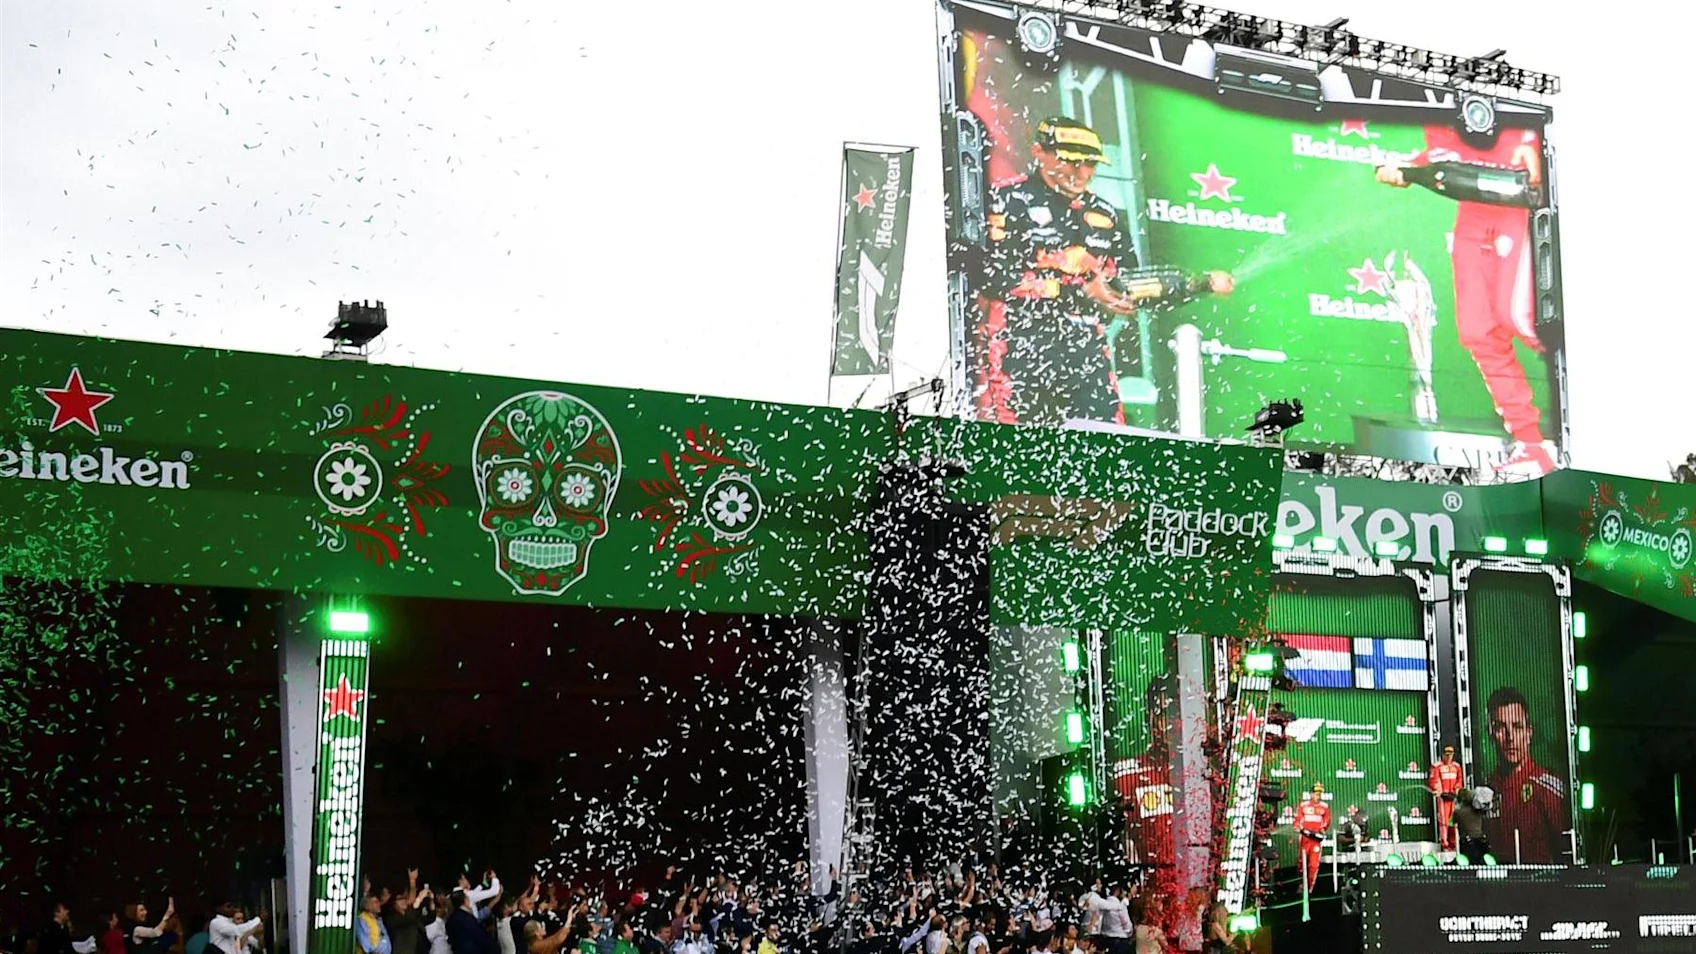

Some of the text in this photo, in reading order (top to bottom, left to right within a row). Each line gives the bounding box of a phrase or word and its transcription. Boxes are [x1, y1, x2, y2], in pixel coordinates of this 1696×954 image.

[875, 156, 901, 249] Heineken
[1147, 198, 1286, 236] Heineken
[103, 423, 123, 434] 1873
[1147, 502, 1269, 538] Paddock
[1623, 527, 1669, 552] MEXICO
[313, 732, 361, 930] Heineken
